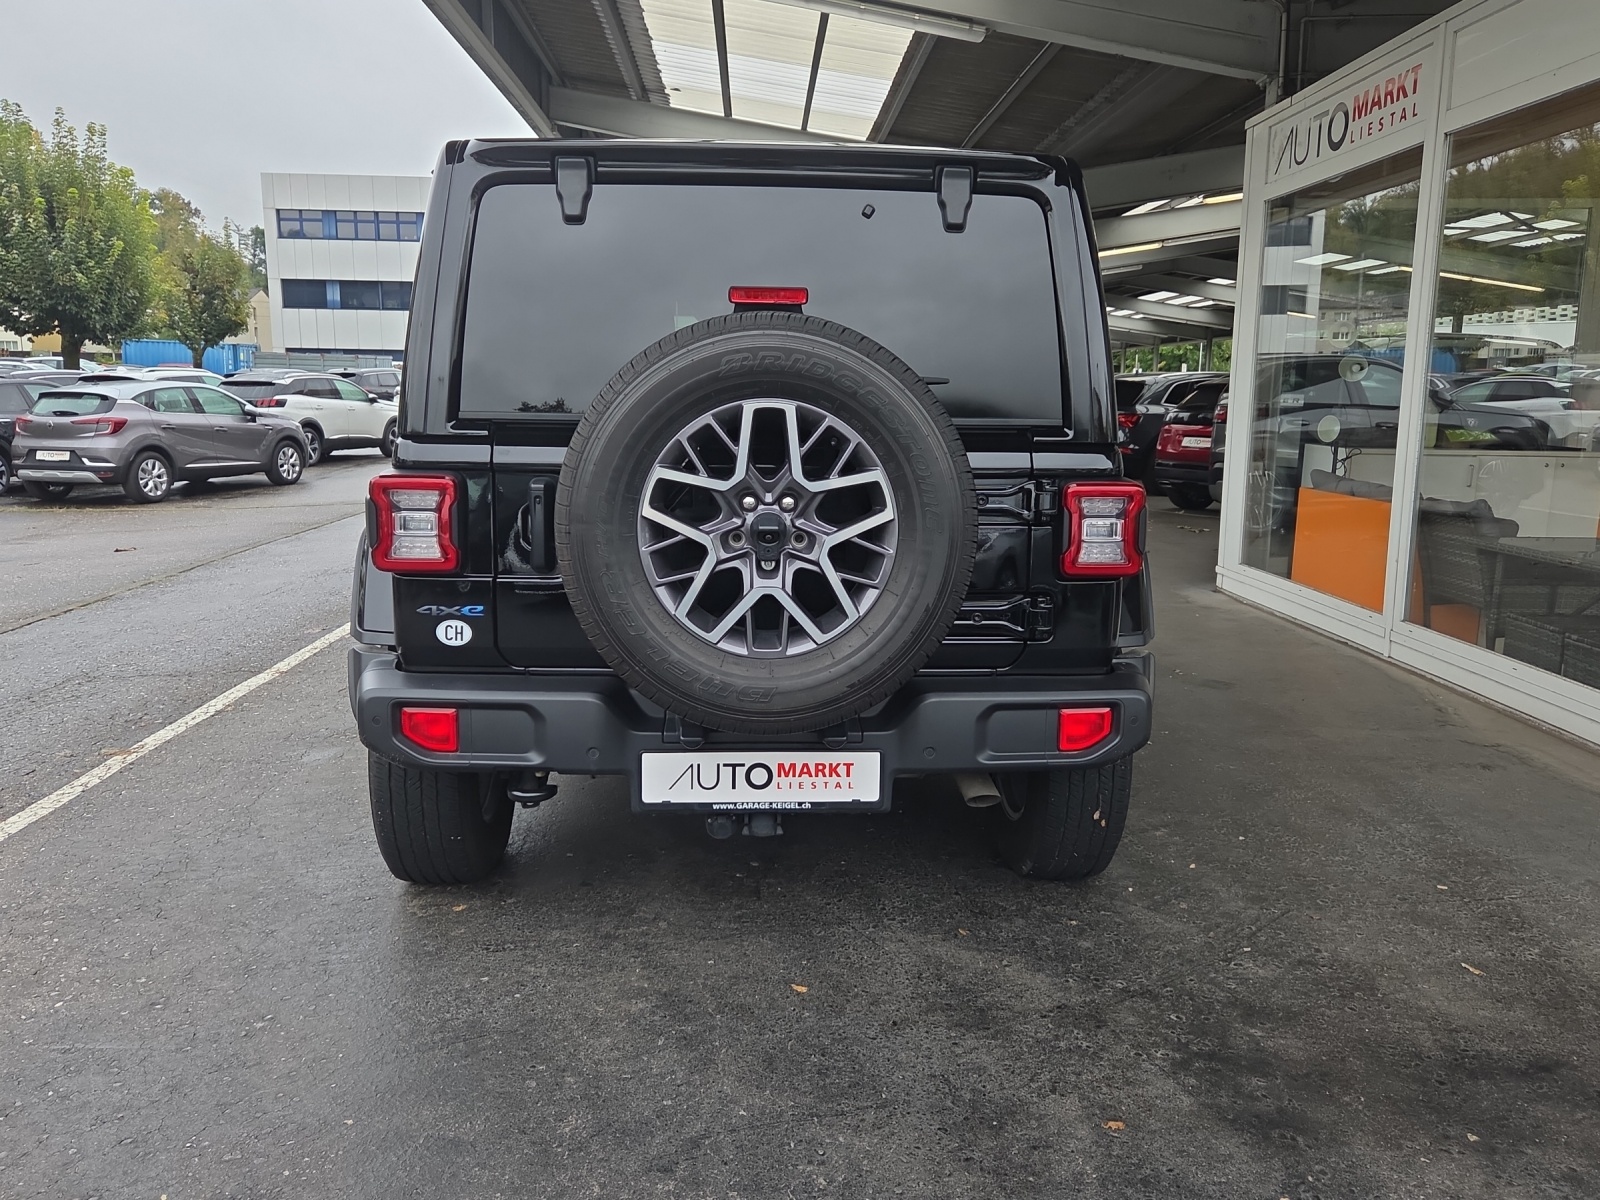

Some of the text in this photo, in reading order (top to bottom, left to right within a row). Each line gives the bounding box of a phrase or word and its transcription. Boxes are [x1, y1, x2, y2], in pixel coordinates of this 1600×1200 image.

[1274, 62, 1423, 175] AUTO MARKT
[1349, 102, 1419, 144] LIESTAL
[717, 350, 943, 536] BRIDGESTONE
[444, 624, 464, 642] CH
[600, 570, 778, 703] DUELER
[668, 762, 855, 790] AUTO MARKT
[776, 781, 854, 790] LIESTAL
[712, 802, 812, 810] www.GARAGE-KEIGEL.ch
